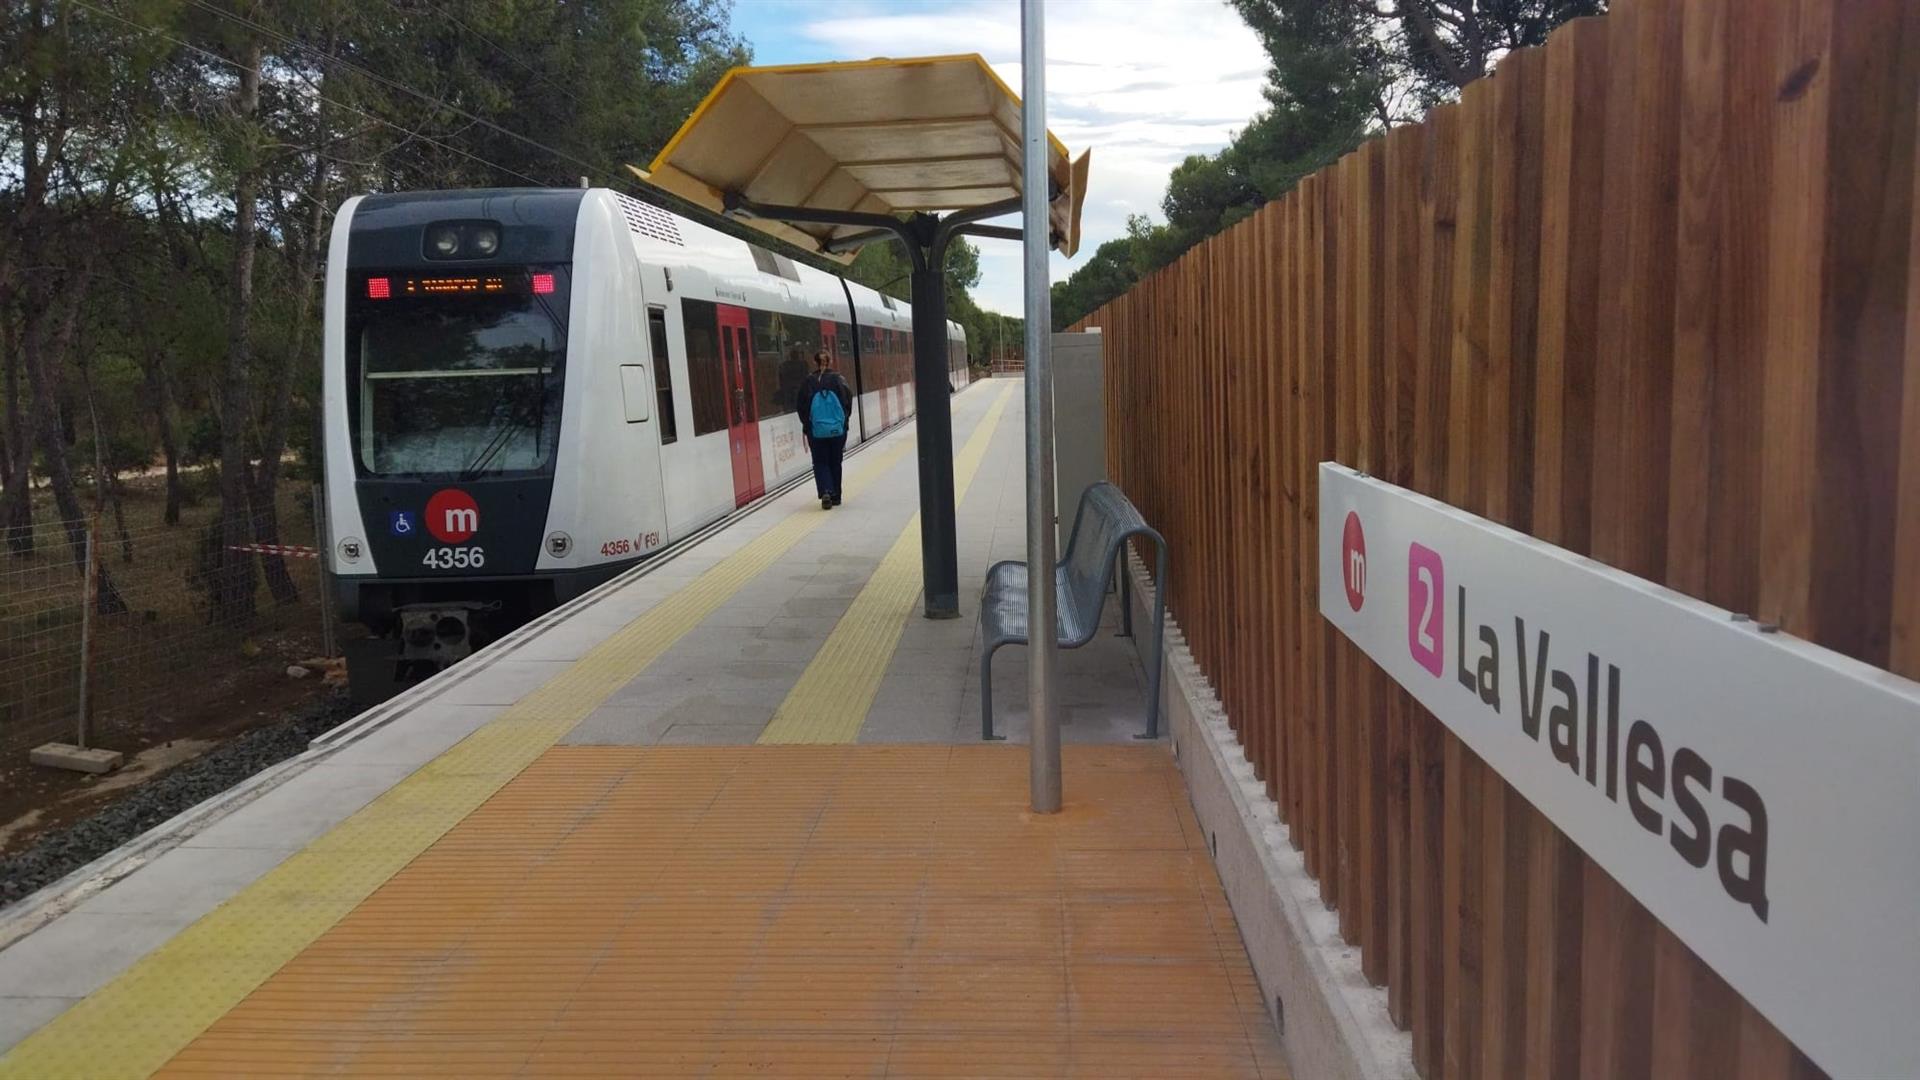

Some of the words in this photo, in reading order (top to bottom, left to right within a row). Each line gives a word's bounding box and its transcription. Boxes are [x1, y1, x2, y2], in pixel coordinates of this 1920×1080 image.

[445, 508, 478, 532] m
[601, 539, 630, 556] 4356
[645, 531, 660, 549] FGV
[422, 546, 485, 569] 4356
[1418, 566, 1434, 653] 2
[1458, 584, 1500, 714] La
[1515, 615, 1769, 925] Vallesa
